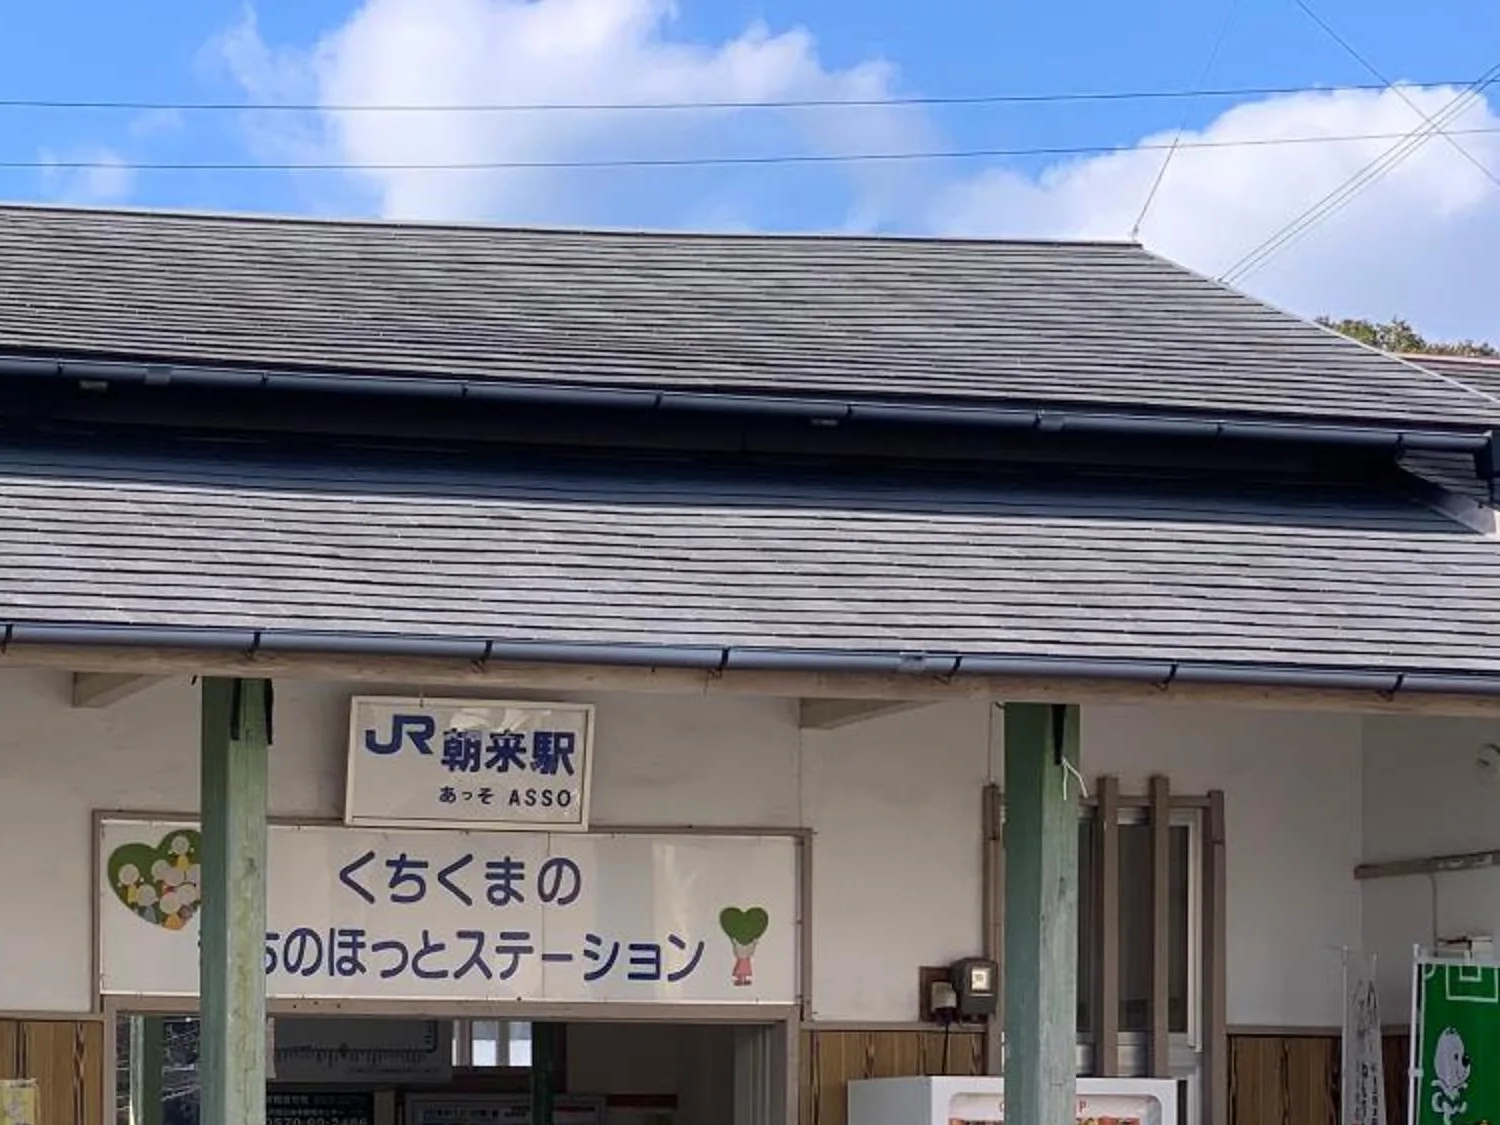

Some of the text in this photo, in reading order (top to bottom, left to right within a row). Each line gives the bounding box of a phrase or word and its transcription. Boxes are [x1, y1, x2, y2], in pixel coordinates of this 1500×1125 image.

[365, 714, 575, 776] JR 朝来駅
[439, 786, 571, 808] あっそ ASSO
[338, 850, 581, 905] くちくまの
